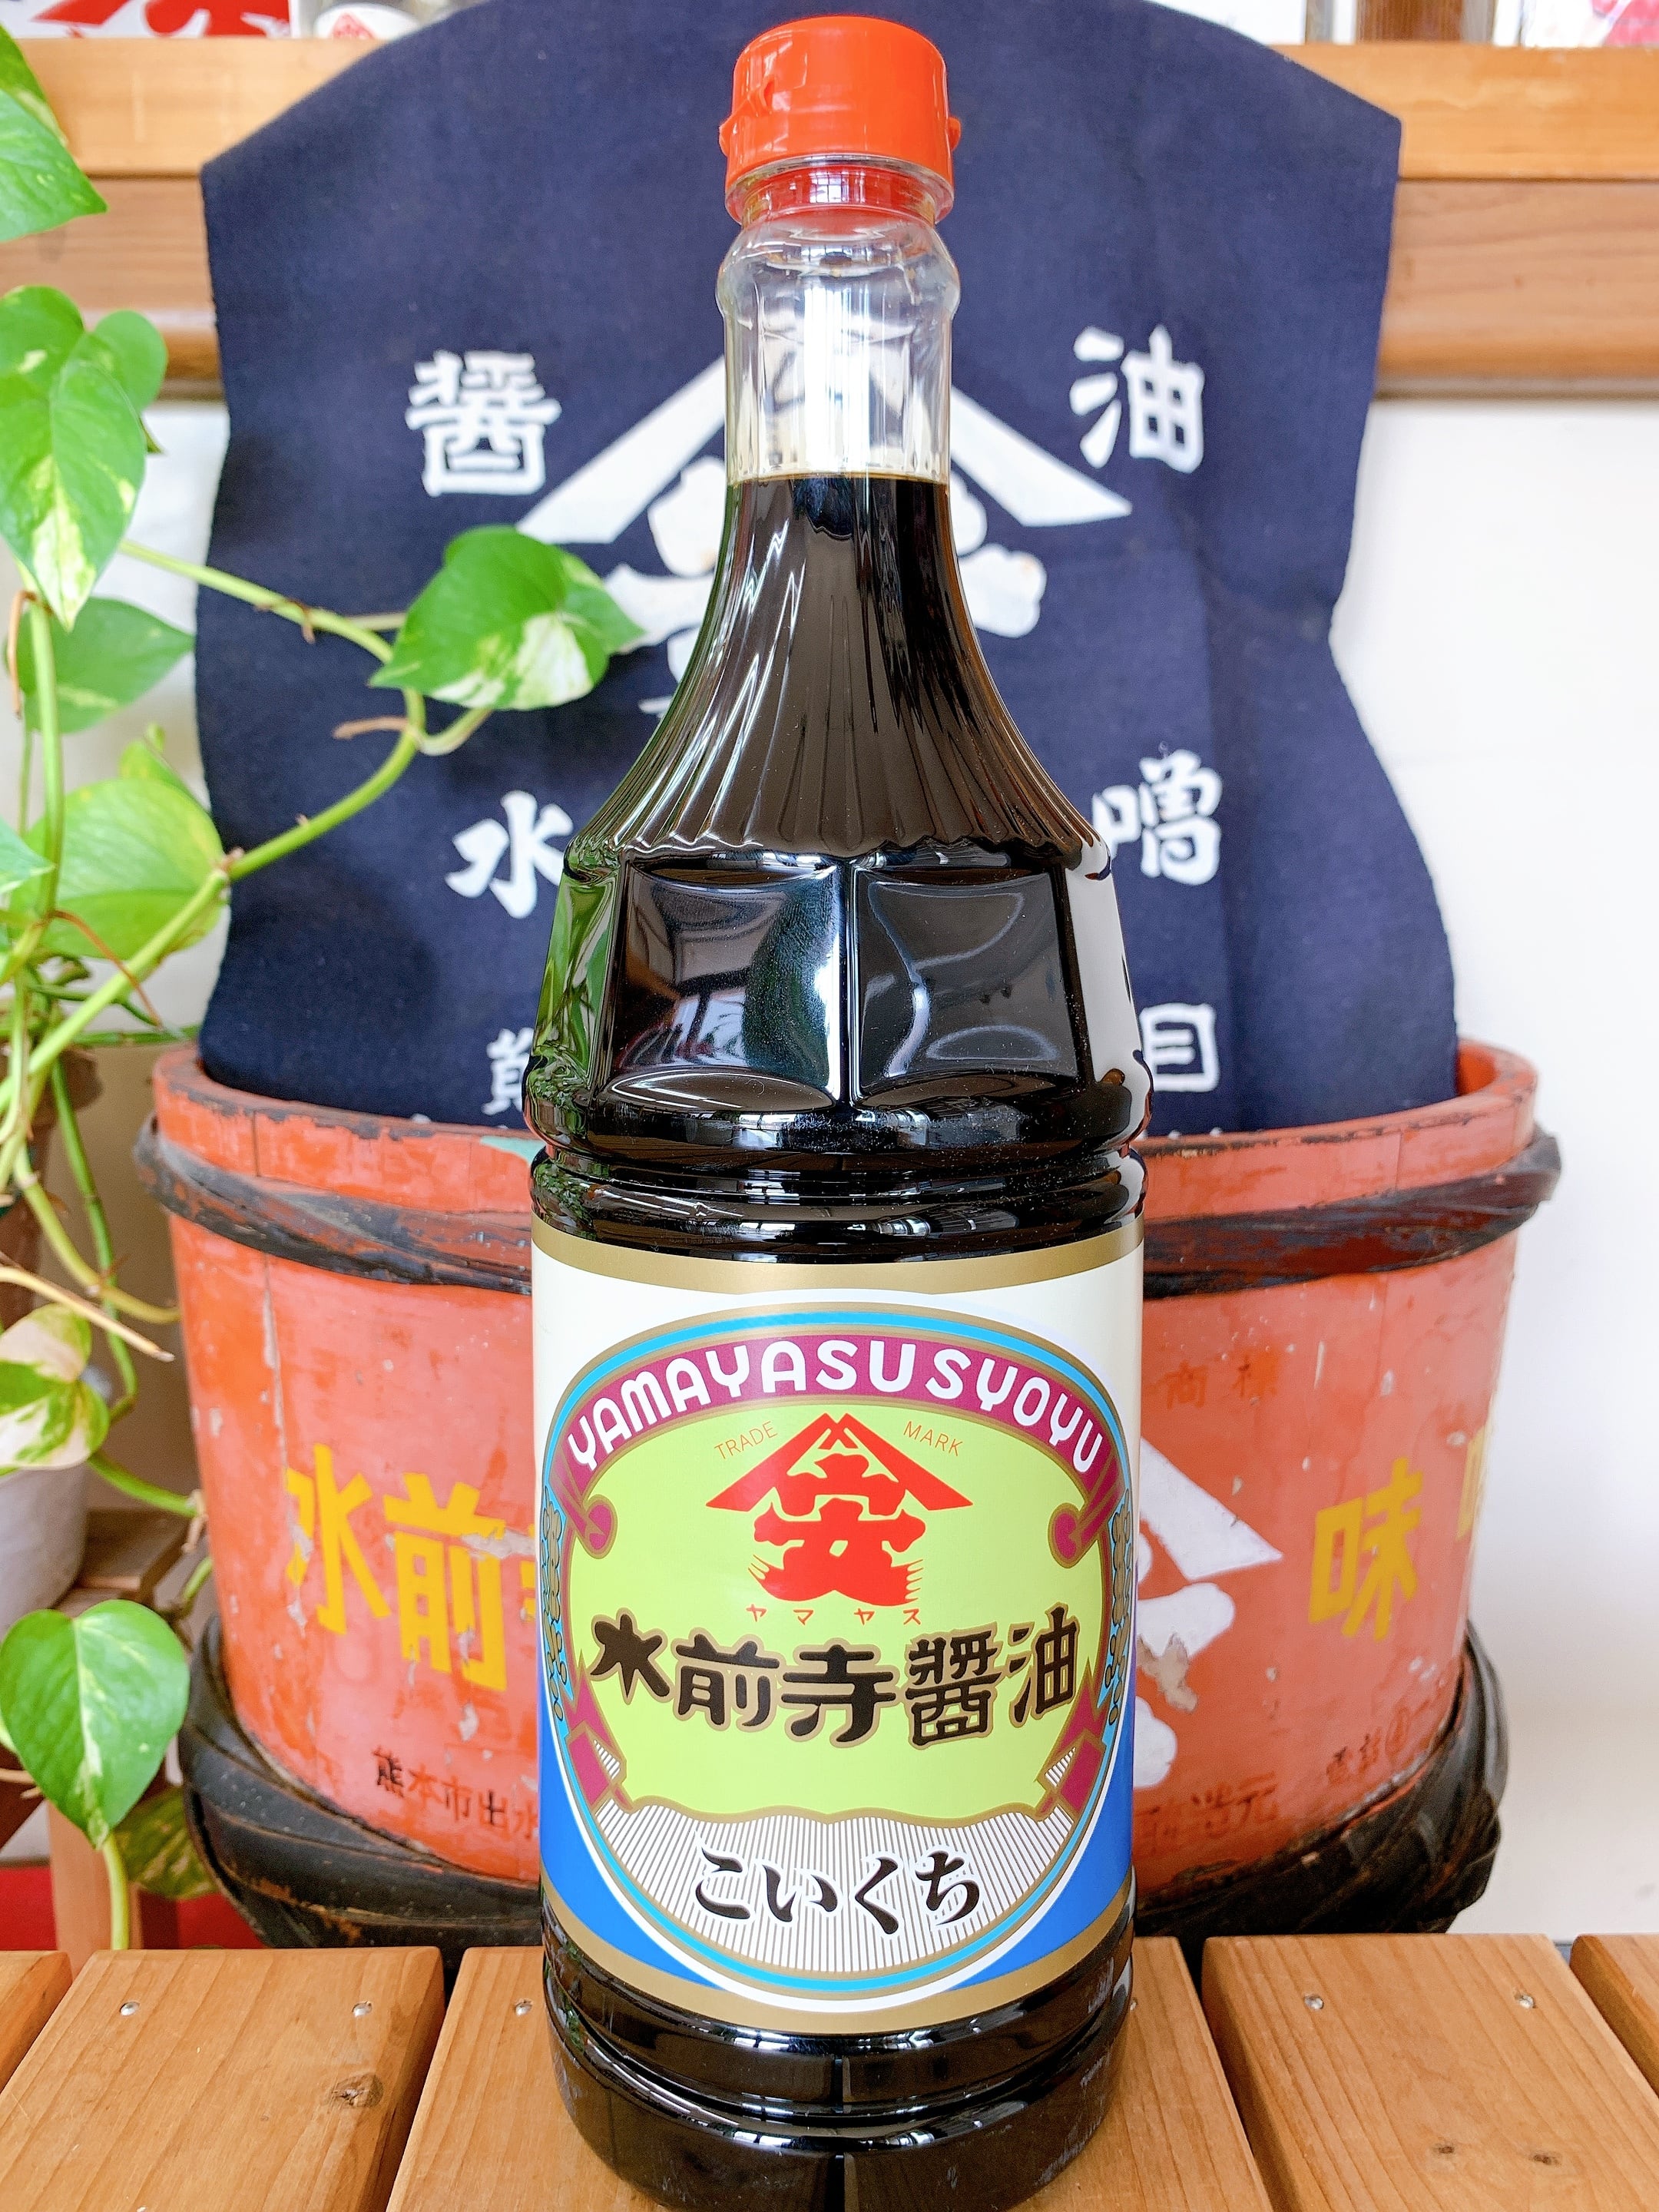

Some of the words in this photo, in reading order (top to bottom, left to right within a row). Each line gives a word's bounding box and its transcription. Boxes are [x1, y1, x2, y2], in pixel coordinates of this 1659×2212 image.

[1070, 324, 1206, 474] 油
[445, 791, 570, 919] 水
[567, 1339, 916, 1470] YAMAYASU
[925, 1348, 1106, 1474] SYOYU
[714, 1420, 778, 1460] TRADE
[902, 1420, 964, 1458] MARK
[286, 1442, 537, 1692] 水前
[746, 1603, 922, 1626] ヤマヤス
[695, 1849, 981, 1934] こいくち
